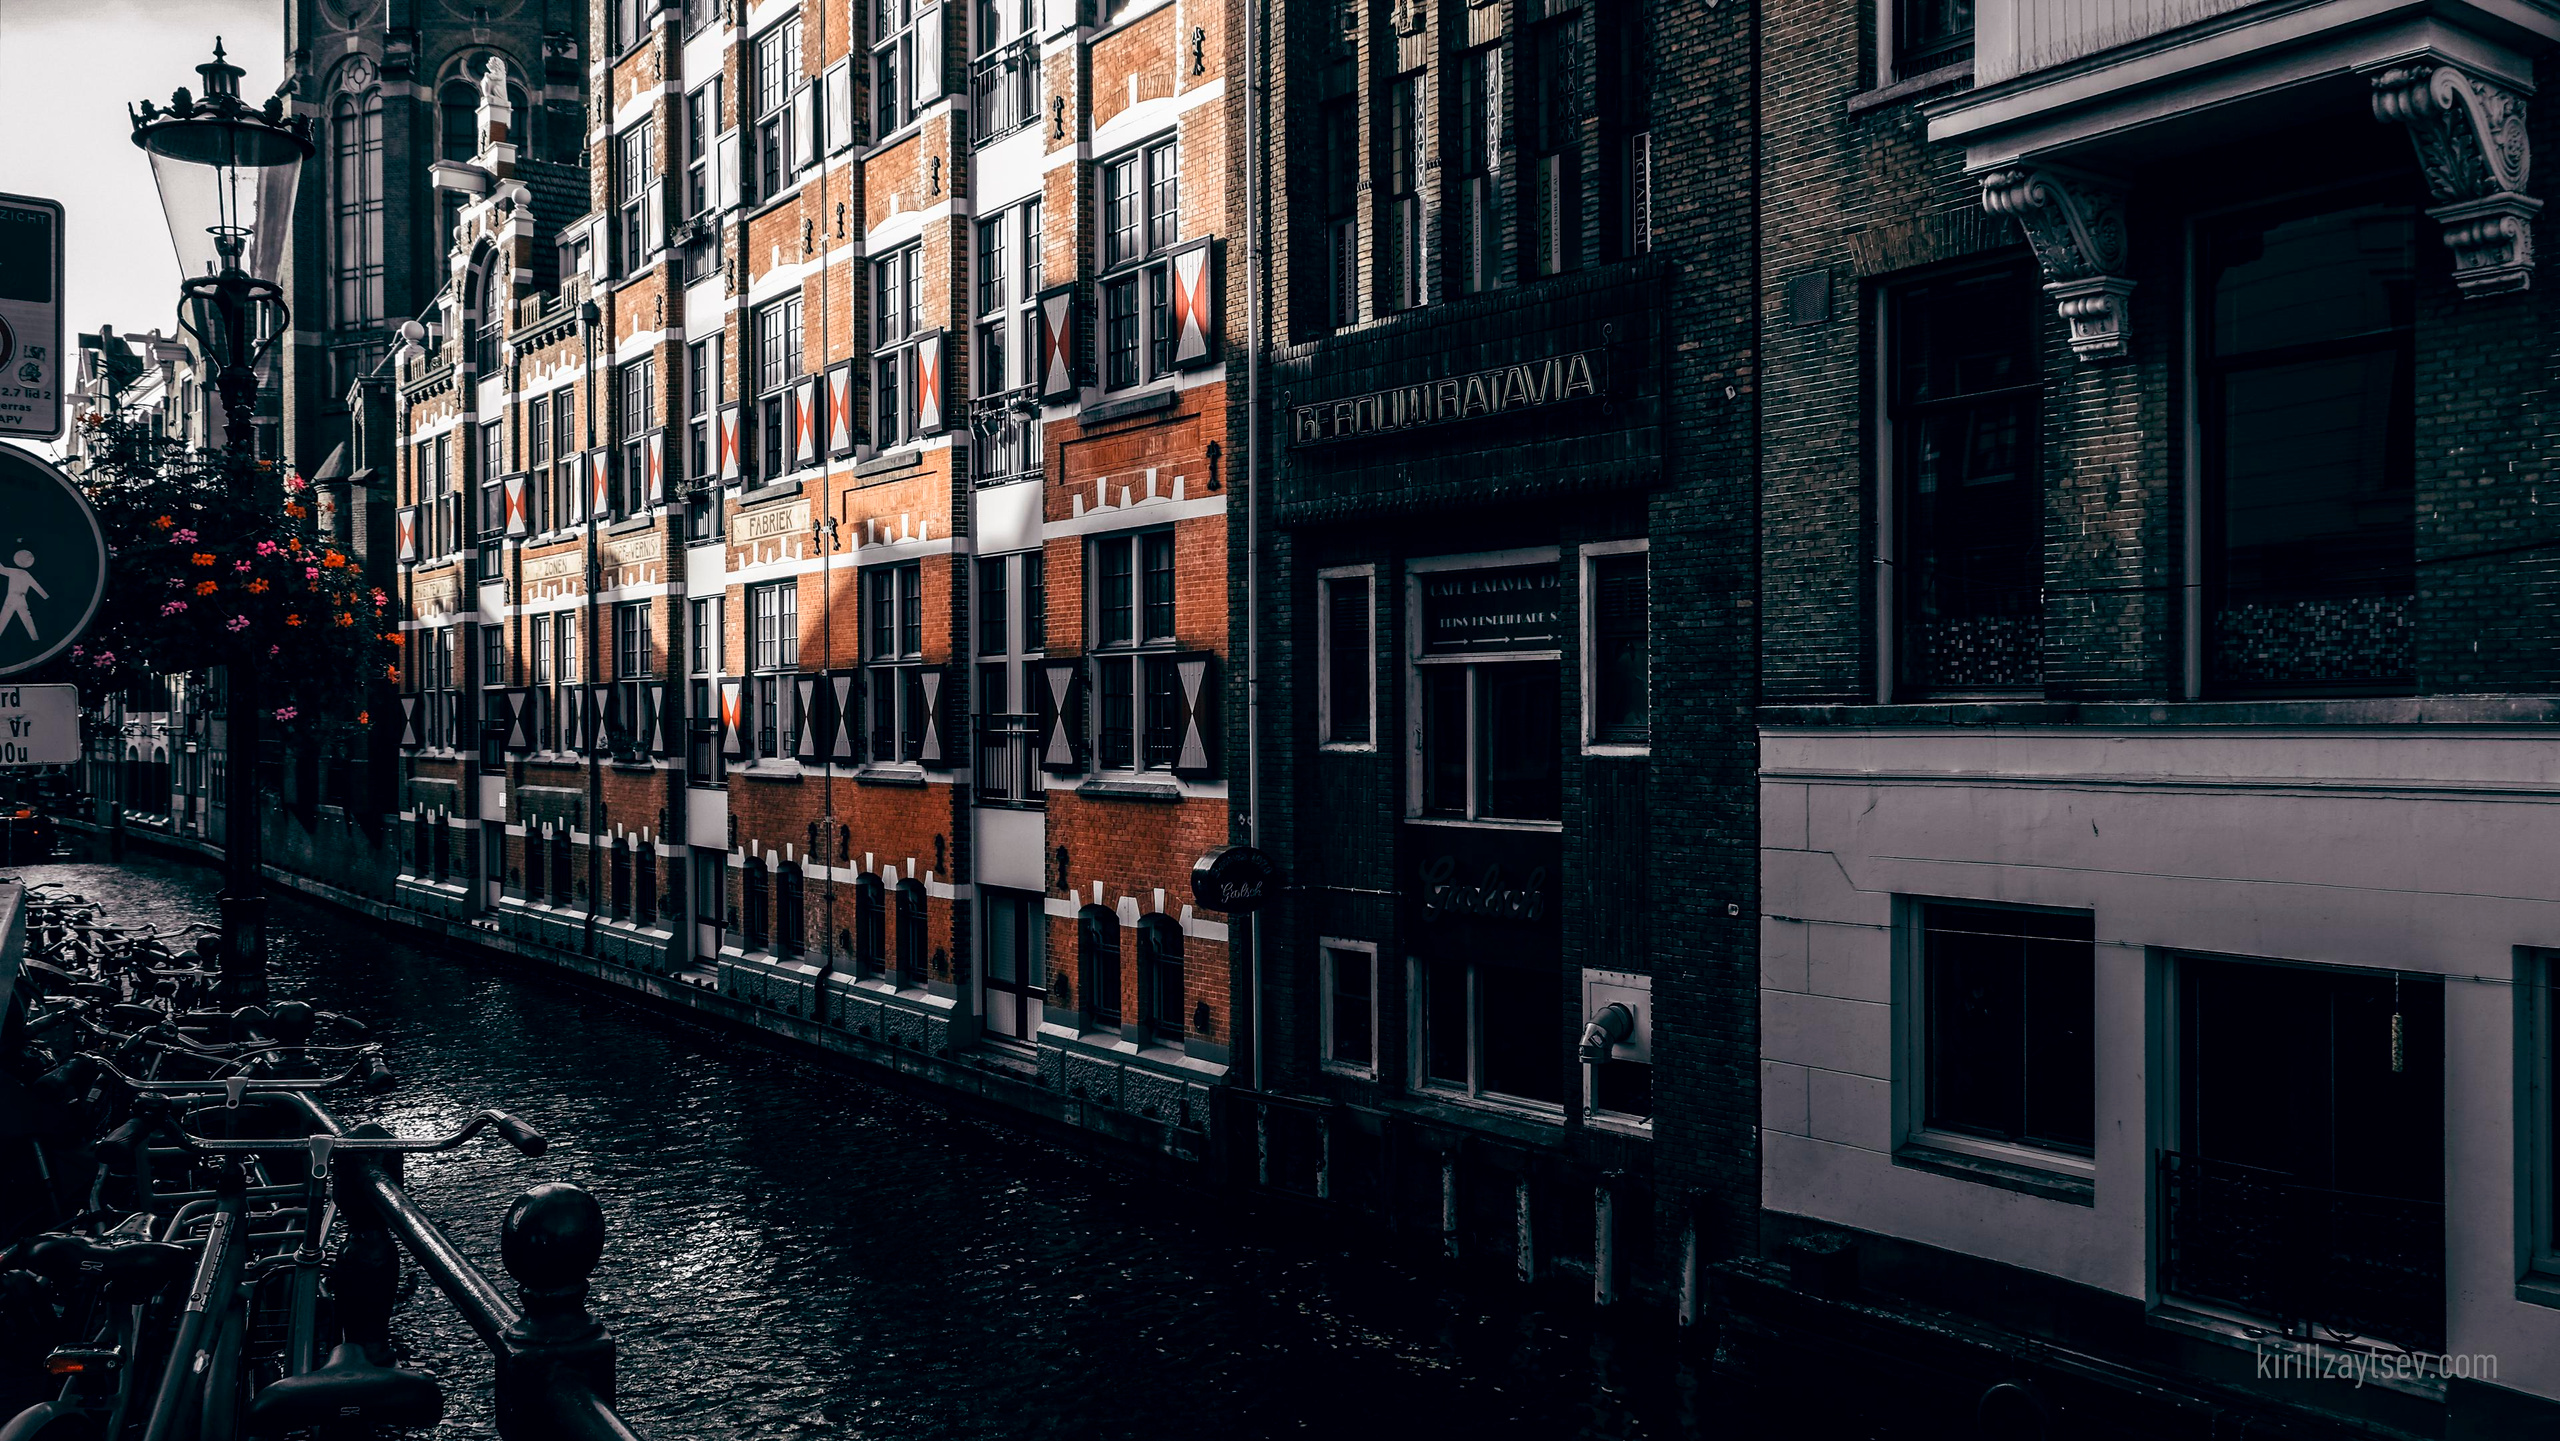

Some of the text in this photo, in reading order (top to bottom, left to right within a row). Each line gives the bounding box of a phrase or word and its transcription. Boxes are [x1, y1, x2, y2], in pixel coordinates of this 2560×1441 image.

[1635, 148, 1646, 244] INDIVIDU
[1541, 171, 1550, 262] INDIVIDU
[1464, 193, 1472, 281] INDIVIDU
[1395, 213, 1404, 298] INDIVIDU
[2, 387, 51, 400] 2.7 lid 2
[1437, 353, 1594, 420] BATAVIA
[0, 402, 32, 412] erras
[749, 509, 793, 537] FABRIEK
[544, 557, 568, 577] ZONEN
[1471, 576, 1533, 594] BATAVIA
[1439, 616, 1469, 629] PRINS
[1472, 612, 1546, 627] HENDRIKKADE
[9, 720, 31, 738] vr
[0, 742, 28, 763] 0u
[1220, 880, 1263, 904] Grolsch
[1417, 855, 1547, 924] Grolsch
